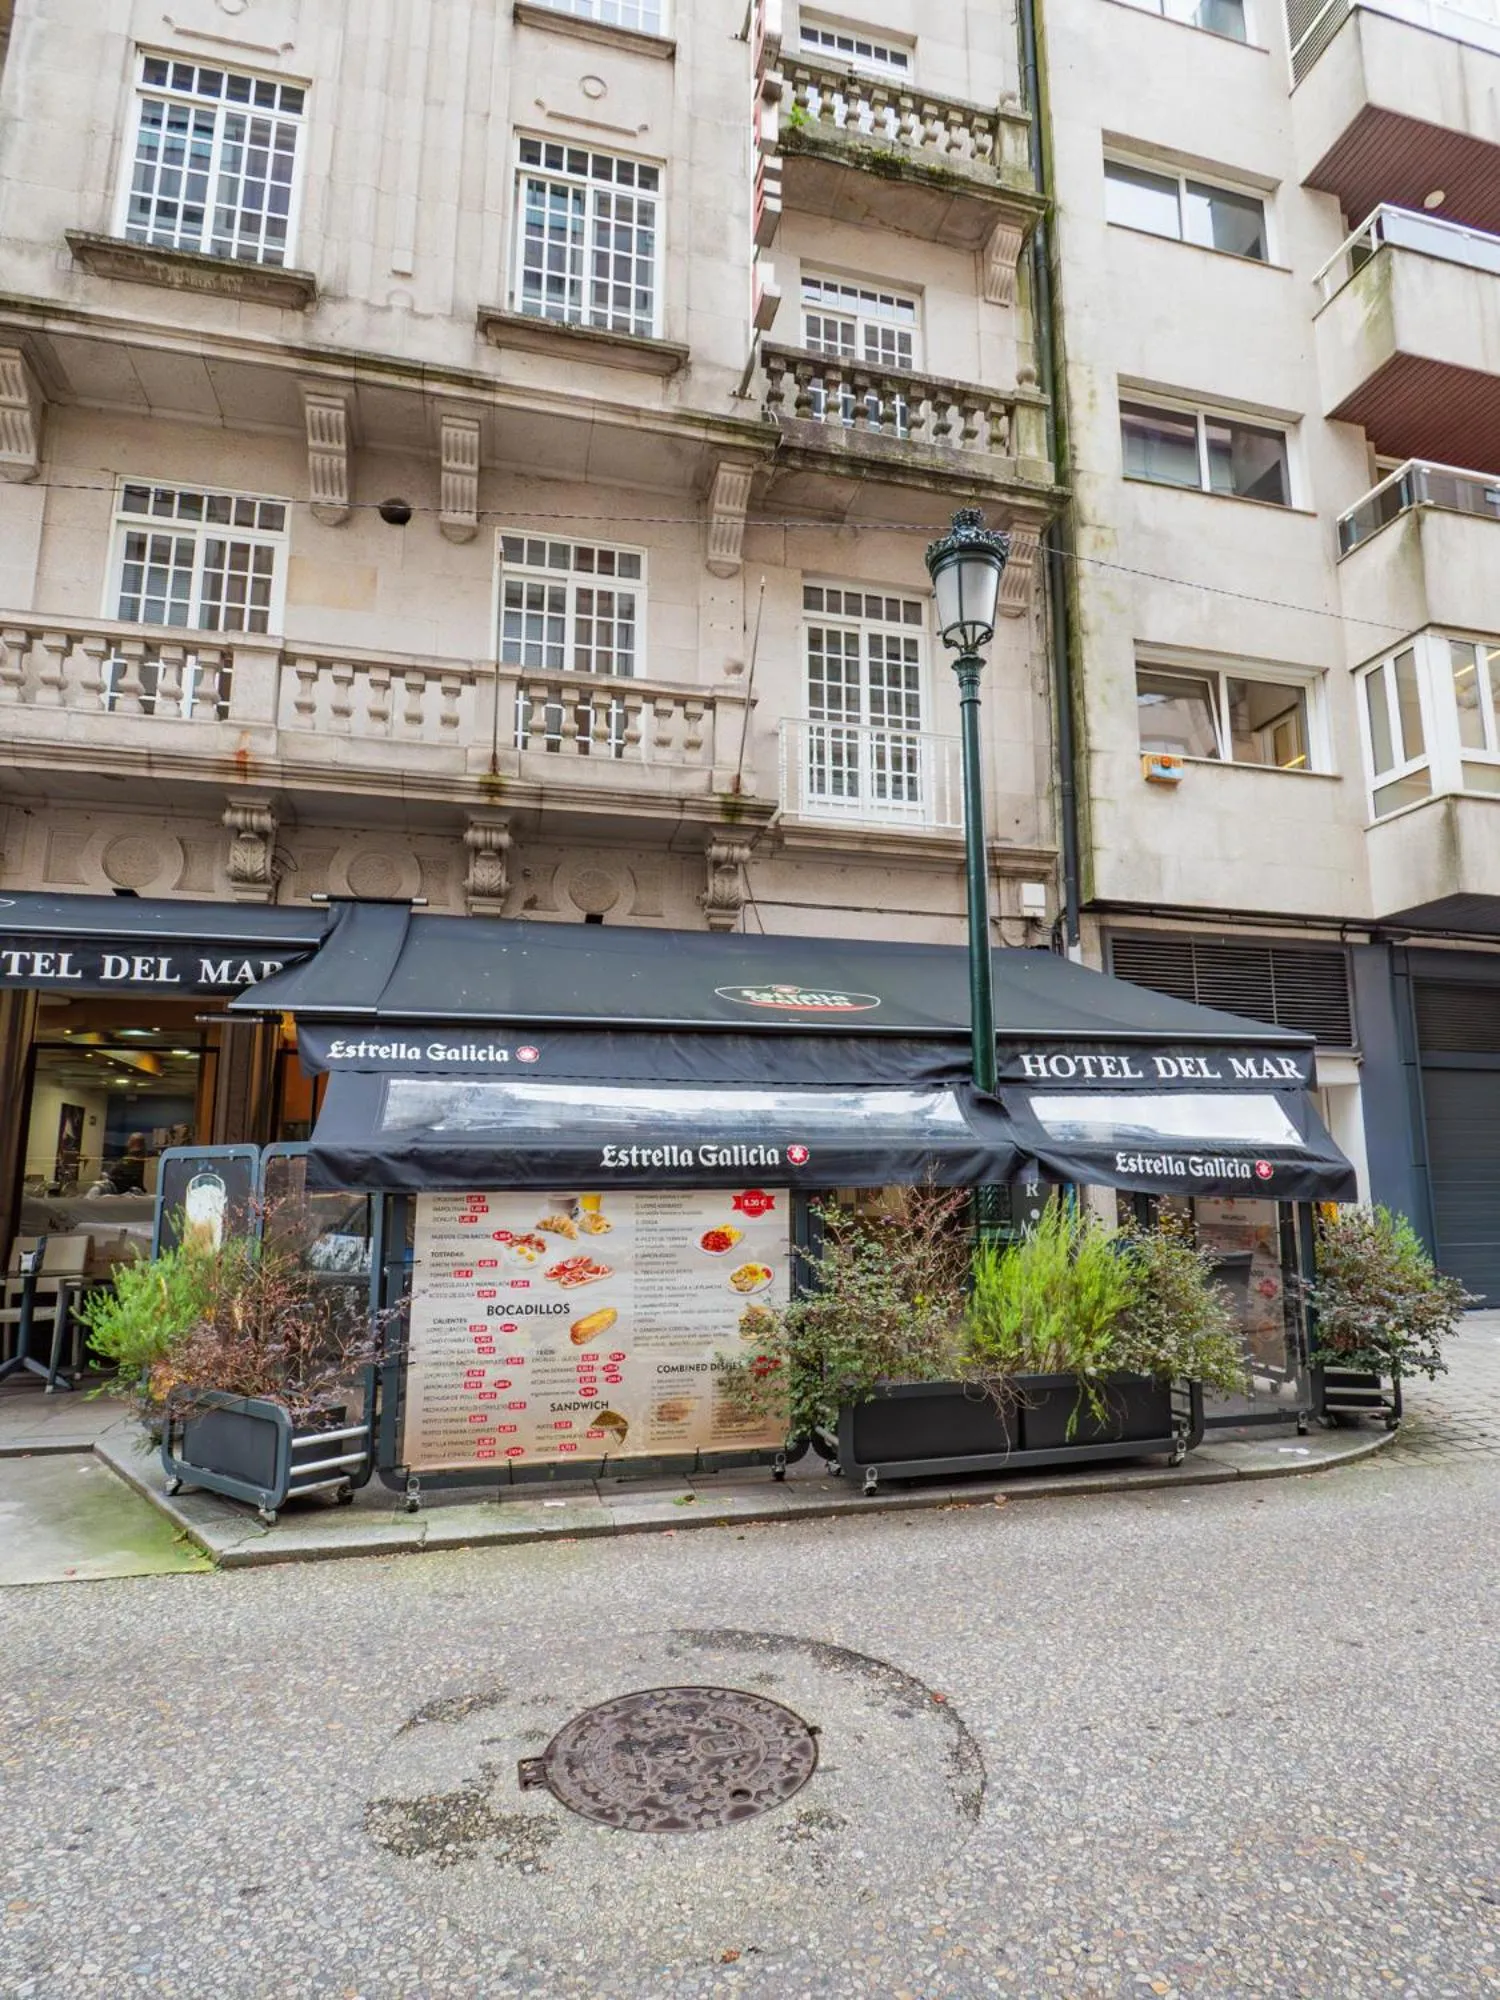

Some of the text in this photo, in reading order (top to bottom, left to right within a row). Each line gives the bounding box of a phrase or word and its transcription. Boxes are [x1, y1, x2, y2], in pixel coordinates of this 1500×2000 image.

[1, 950, 82, 979] TEL
[99, 953, 181, 982] DEL
[326, 1040, 510, 1062] Estrella Galicia
[1019, 1054, 1306, 1080] HOTEL DEL MAR
[600, 1143, 780, 1168] Estrella Galicia
[1115, 1151, 1251, 1179] Estrella Galicia
[487, 1303, 570, 1316] BOCADILLOS
[656, 1363, 708, 1374] COMBINED
[550, 1400, 609, 1412] SANDWICH
